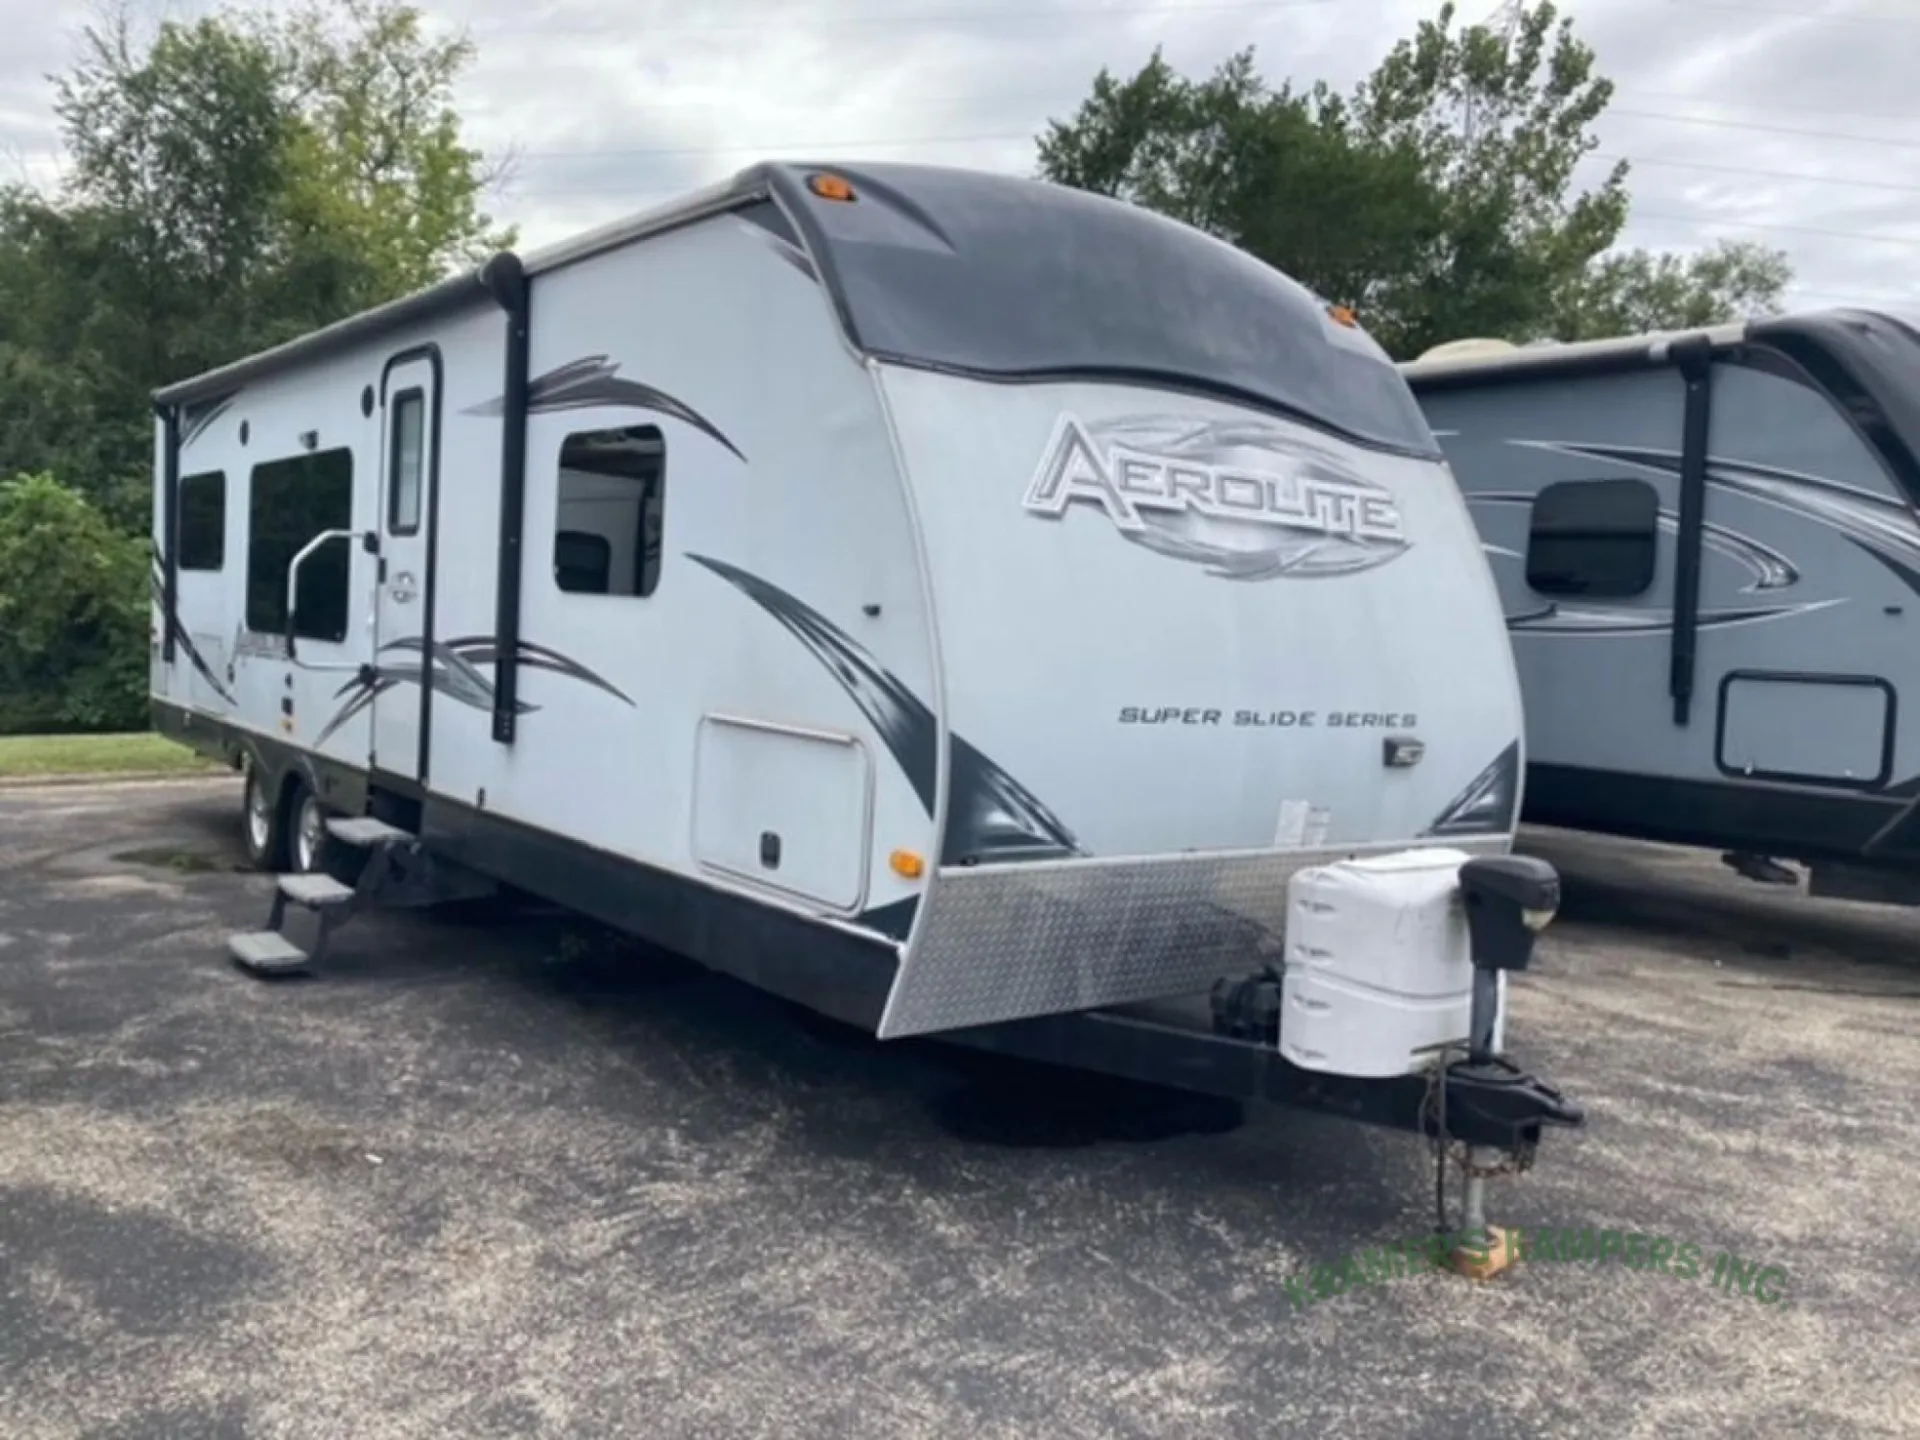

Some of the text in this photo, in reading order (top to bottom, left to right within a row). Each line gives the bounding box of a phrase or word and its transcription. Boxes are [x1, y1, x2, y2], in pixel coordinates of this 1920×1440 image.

[1022, 410, 1405, 540] AEROLITE
[1118, 706, 1418, 728] SUPER SLIDE SERIES
